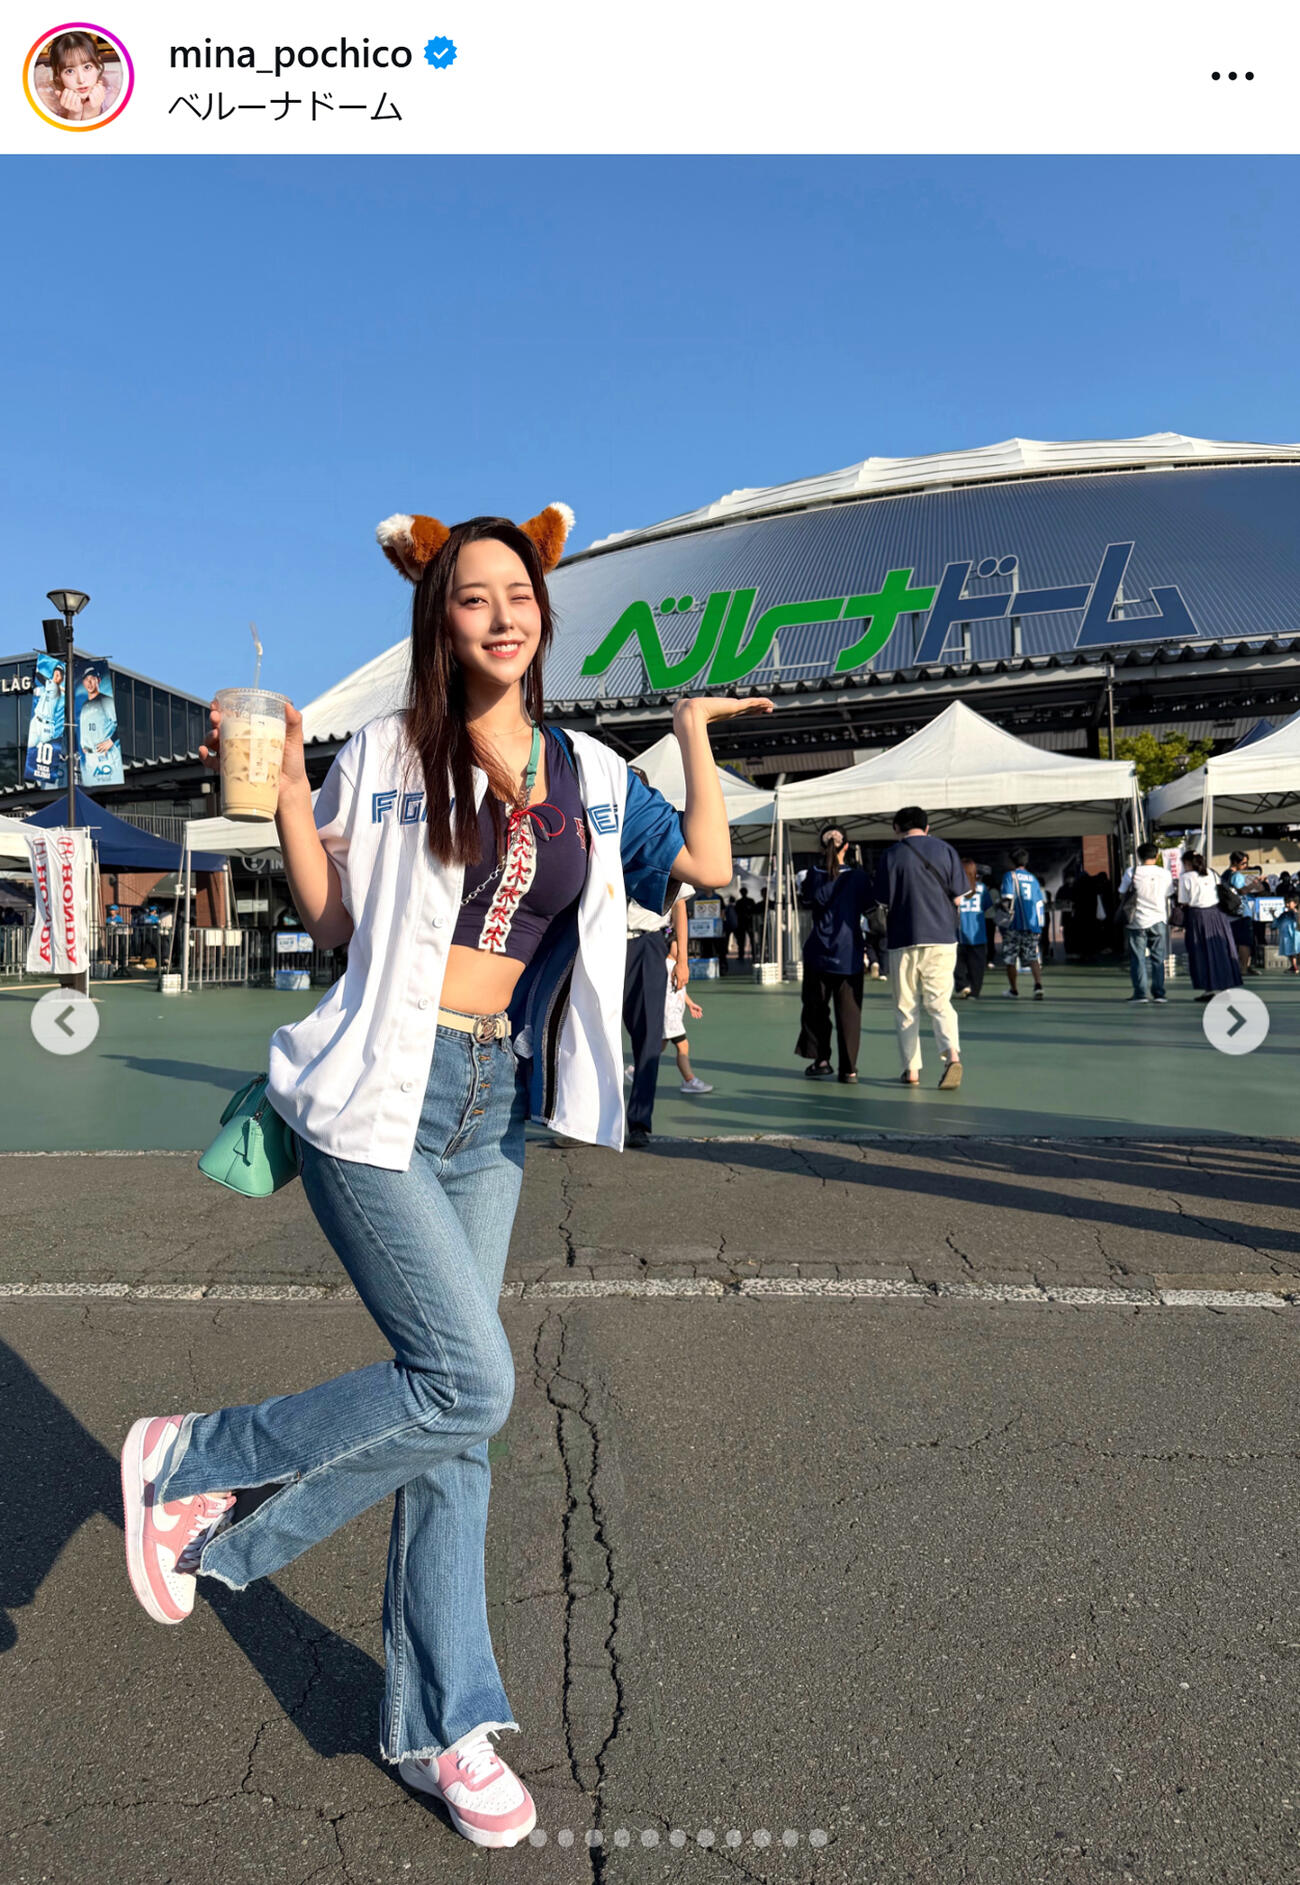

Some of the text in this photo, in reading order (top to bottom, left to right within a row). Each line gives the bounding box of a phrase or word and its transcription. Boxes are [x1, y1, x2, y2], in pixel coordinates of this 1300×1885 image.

[580, 540, 1200, 691] ベルーナドーム
[36, 741, 53, 765] 10
